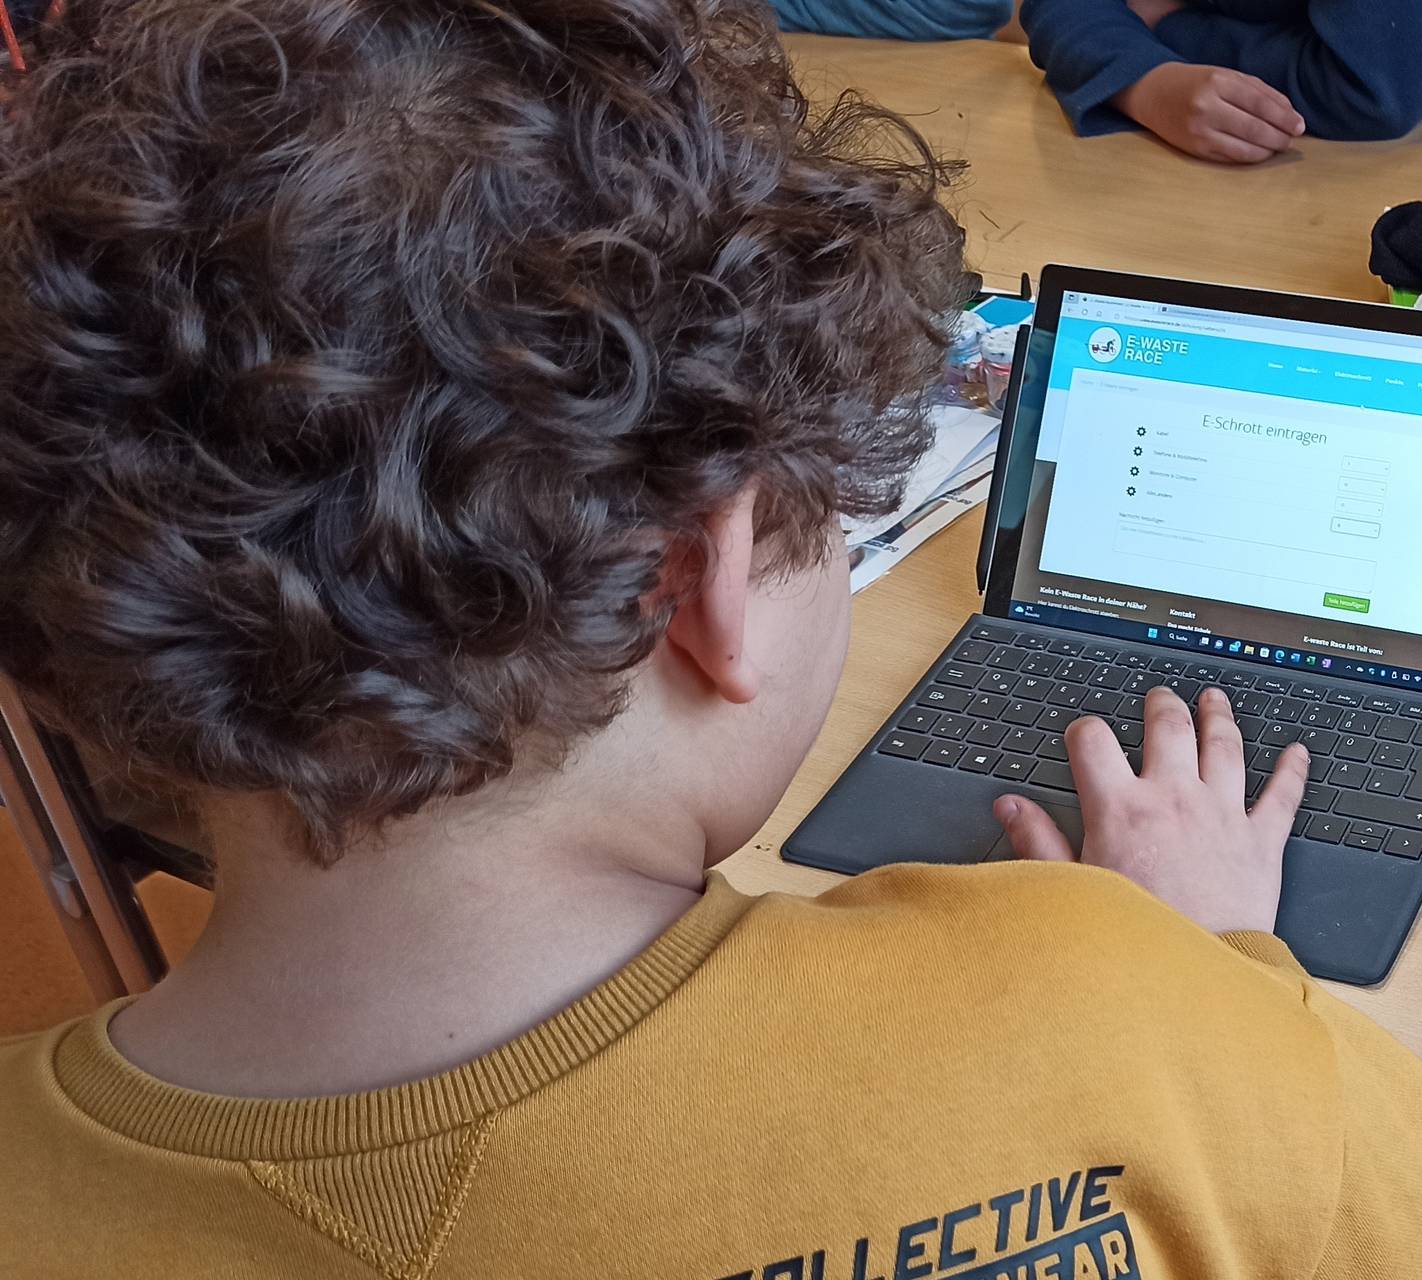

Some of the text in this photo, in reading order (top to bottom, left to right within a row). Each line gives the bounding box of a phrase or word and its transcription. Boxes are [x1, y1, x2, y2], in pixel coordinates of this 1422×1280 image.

[1125, 349, 1163, 365] RACE
[1126, 334, 1189, 355] E-WASTE
[1202, 414, 1328, 446] E-Schrott eintragen
[1169, 608, 1196, 619] Kontakt
[713, 1165, 1125, 1280] LECTIVE
[980, 1229, 1130, 1280] EAR
